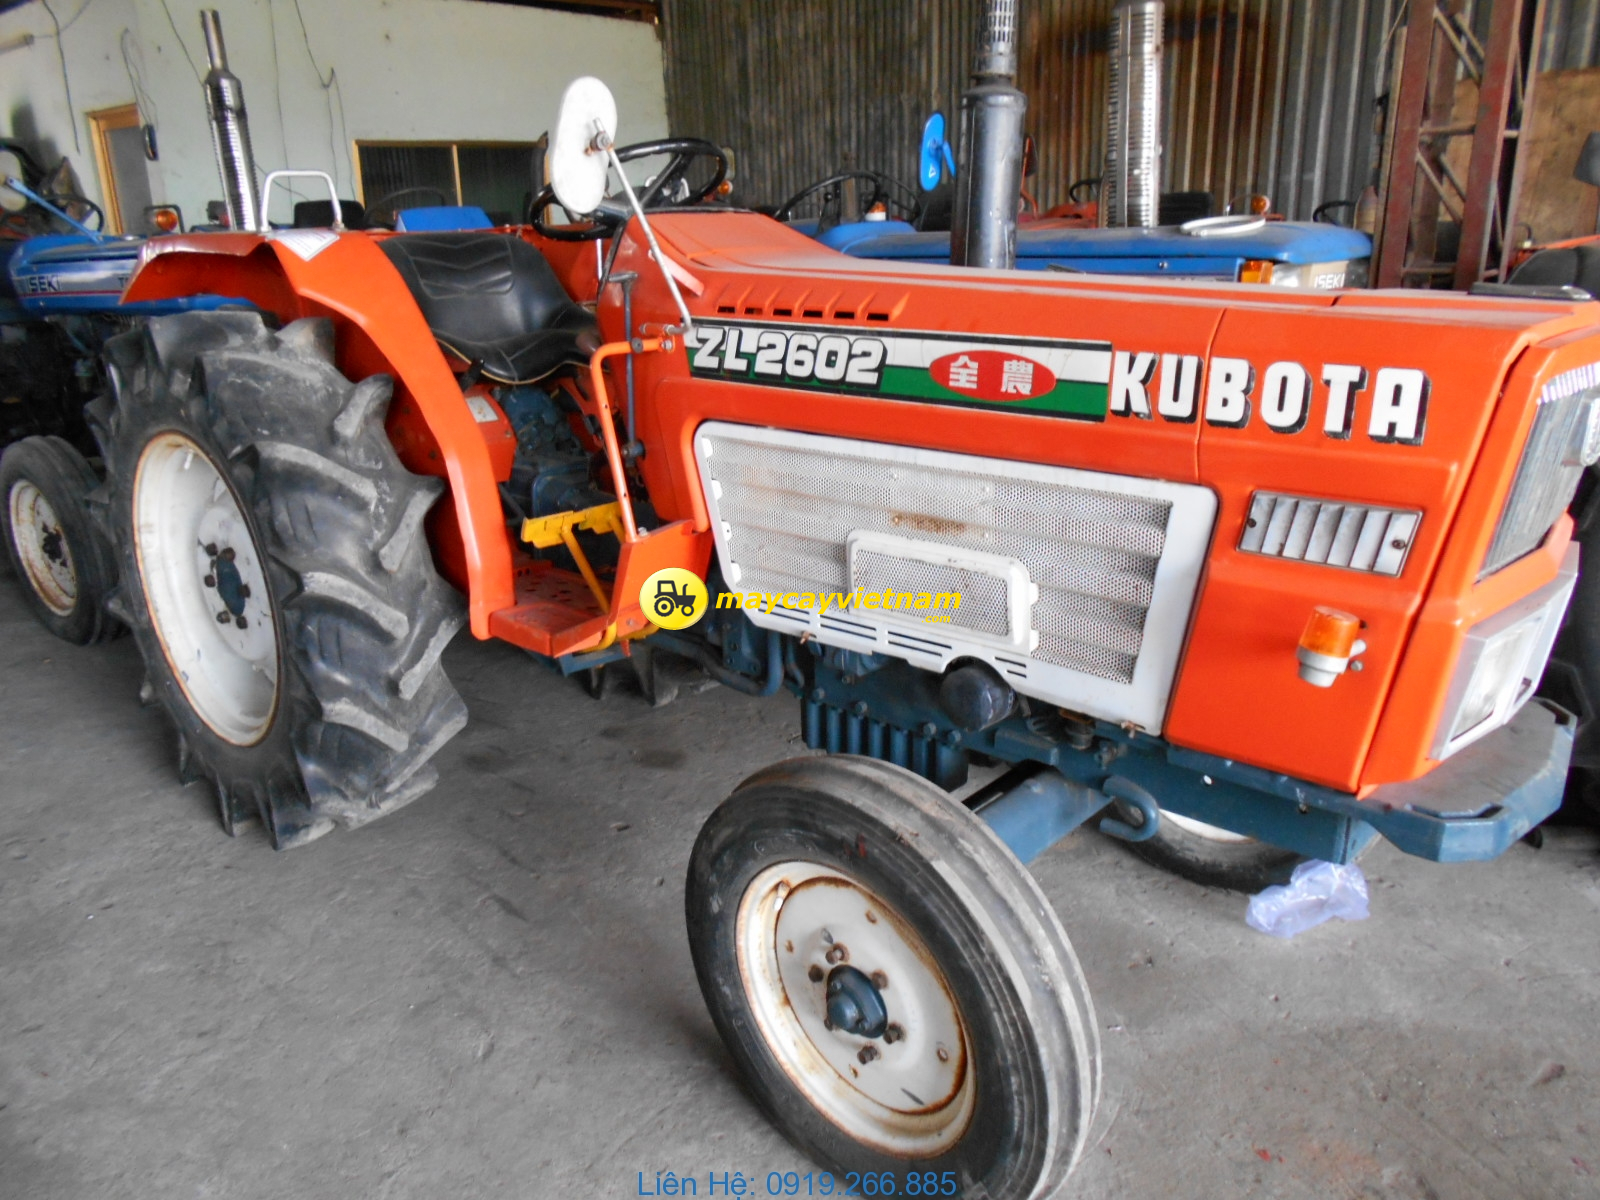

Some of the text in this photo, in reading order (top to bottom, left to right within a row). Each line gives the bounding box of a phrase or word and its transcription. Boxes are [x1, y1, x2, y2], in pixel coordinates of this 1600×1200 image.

[1314, 272, 1345, 288] ISEKI
[692, 324, 886, 390] ZL2602
[1110, 350, 1431, 445] KUBOTA
